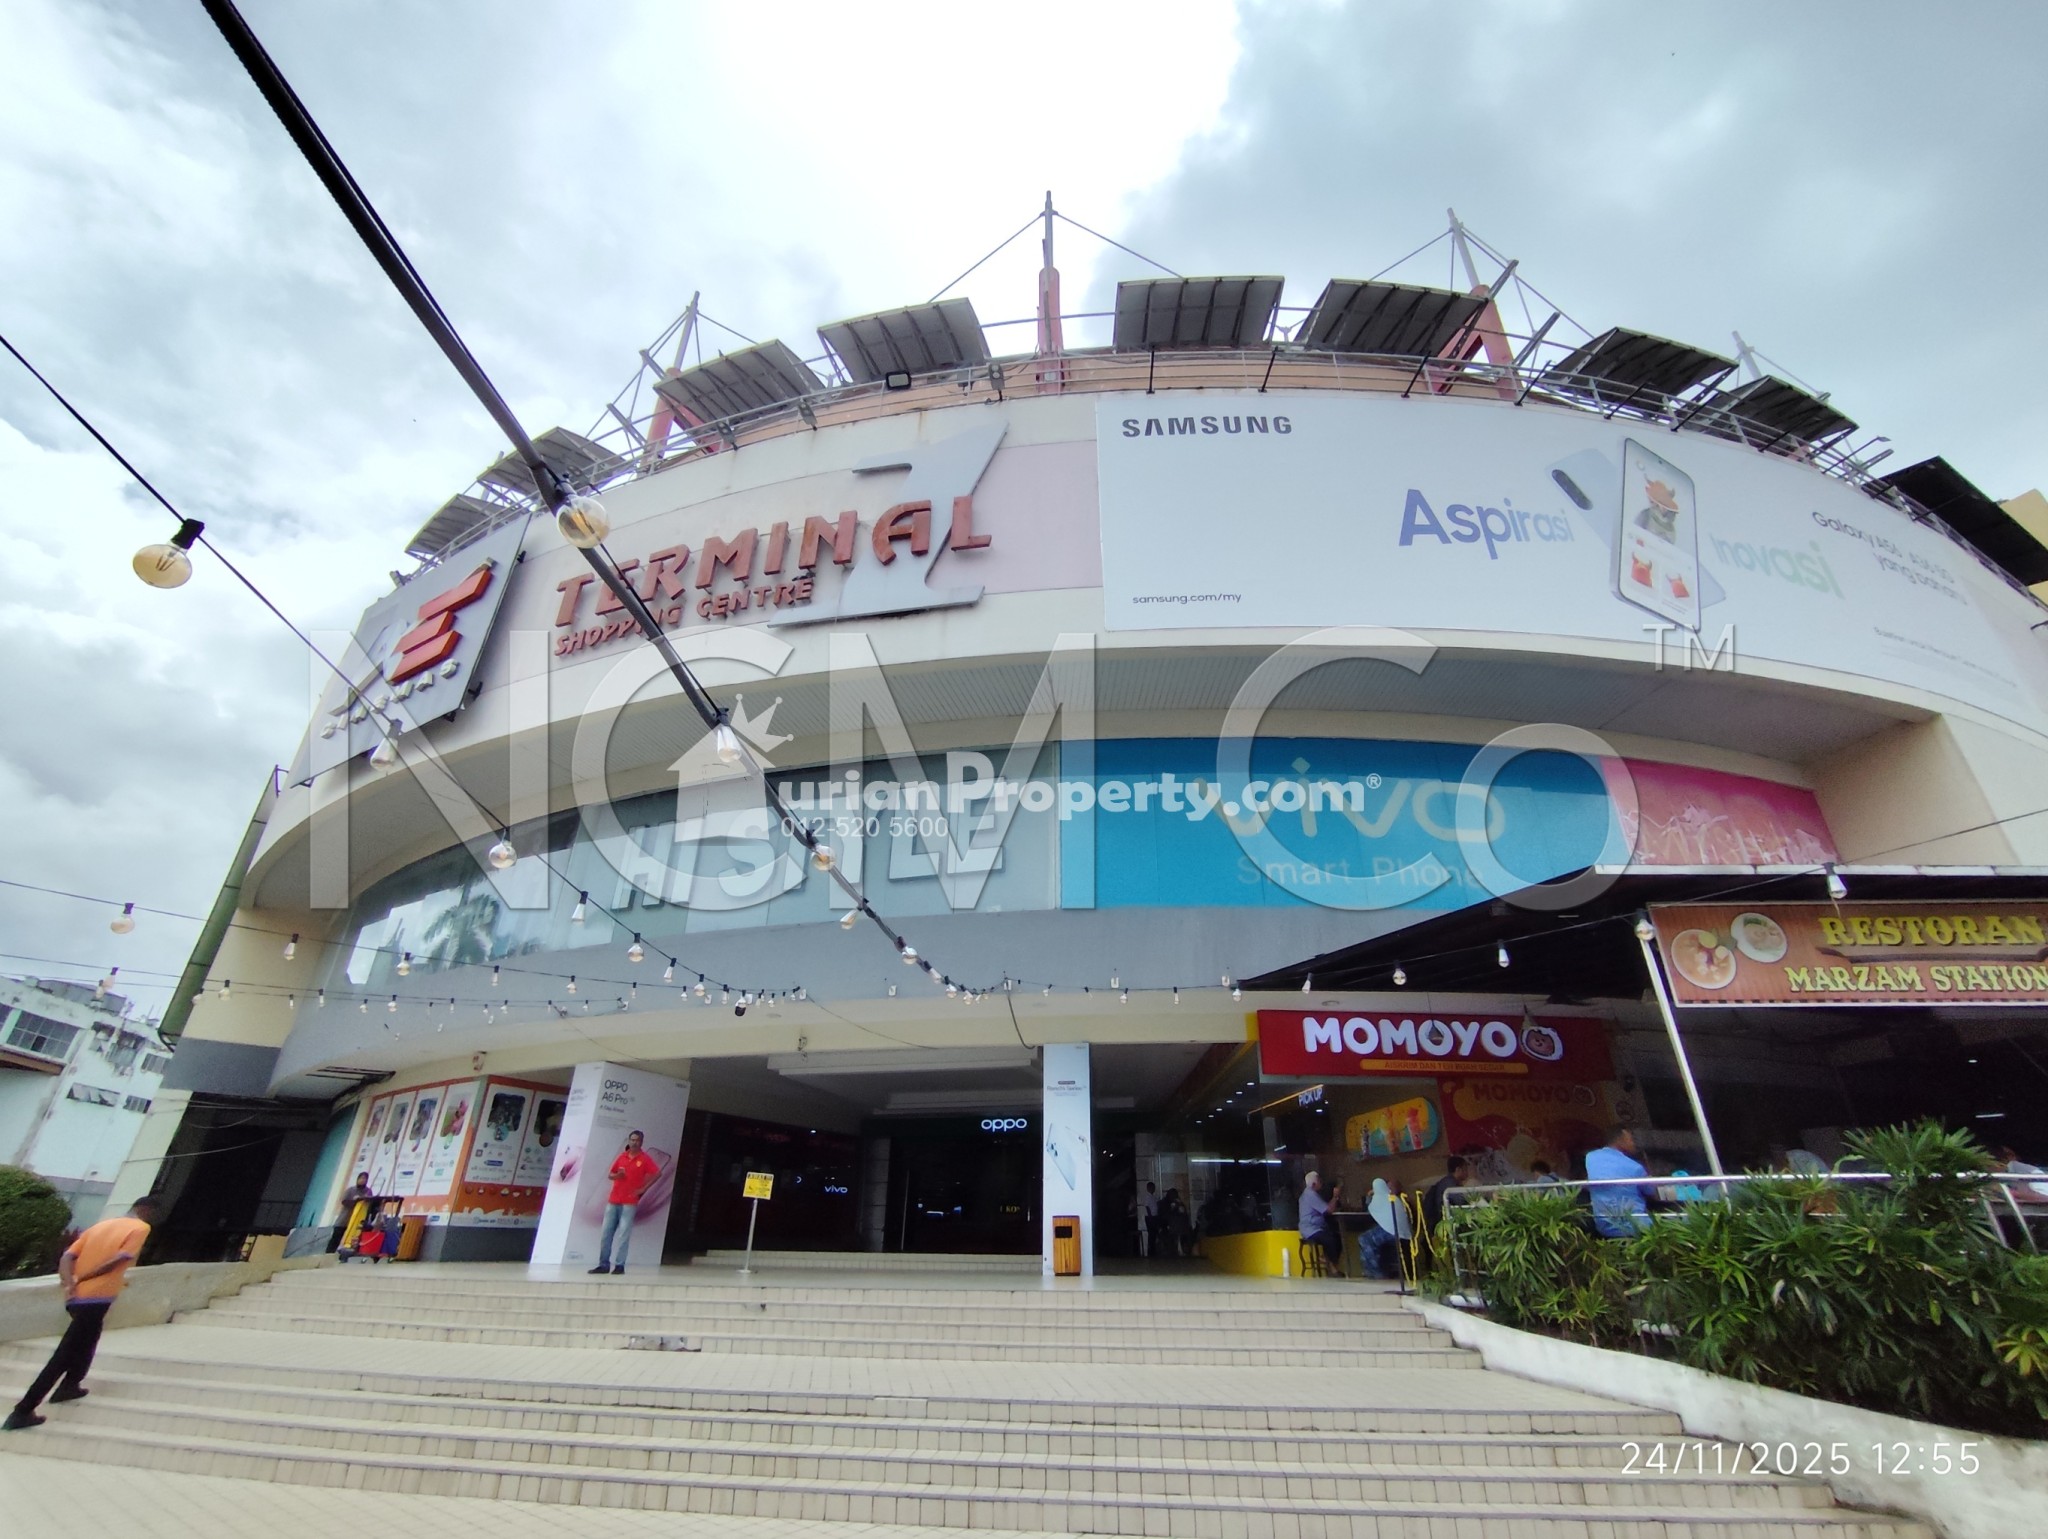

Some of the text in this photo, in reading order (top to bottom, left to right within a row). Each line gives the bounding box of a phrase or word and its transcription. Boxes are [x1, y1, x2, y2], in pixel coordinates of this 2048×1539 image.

[1122, 415, 1292, 438] SAMSUNG
[1398, 488, 1575, 560] Aspirasi
[554, 494, 993, 628] TERMINAL
[696, 577, 814, 620] CENTRE
[1132, 592, 1242, 605] samsung.com/my
[1192, 757, 1506, 844] vivo
[1236, 855, 1485, 889] Smart Phone
[1818, 915, 2046, 945] RESTORAN
[1784, 965, 2048, 992] MARZAM STATION
[1302, 1016, 1518, 1058] MOMOYO
[604, 1079, 629, 1093] OPPO
[981, 1118, 1028, 1132] oppo
[824, 1184, 848, 1194] vivo
